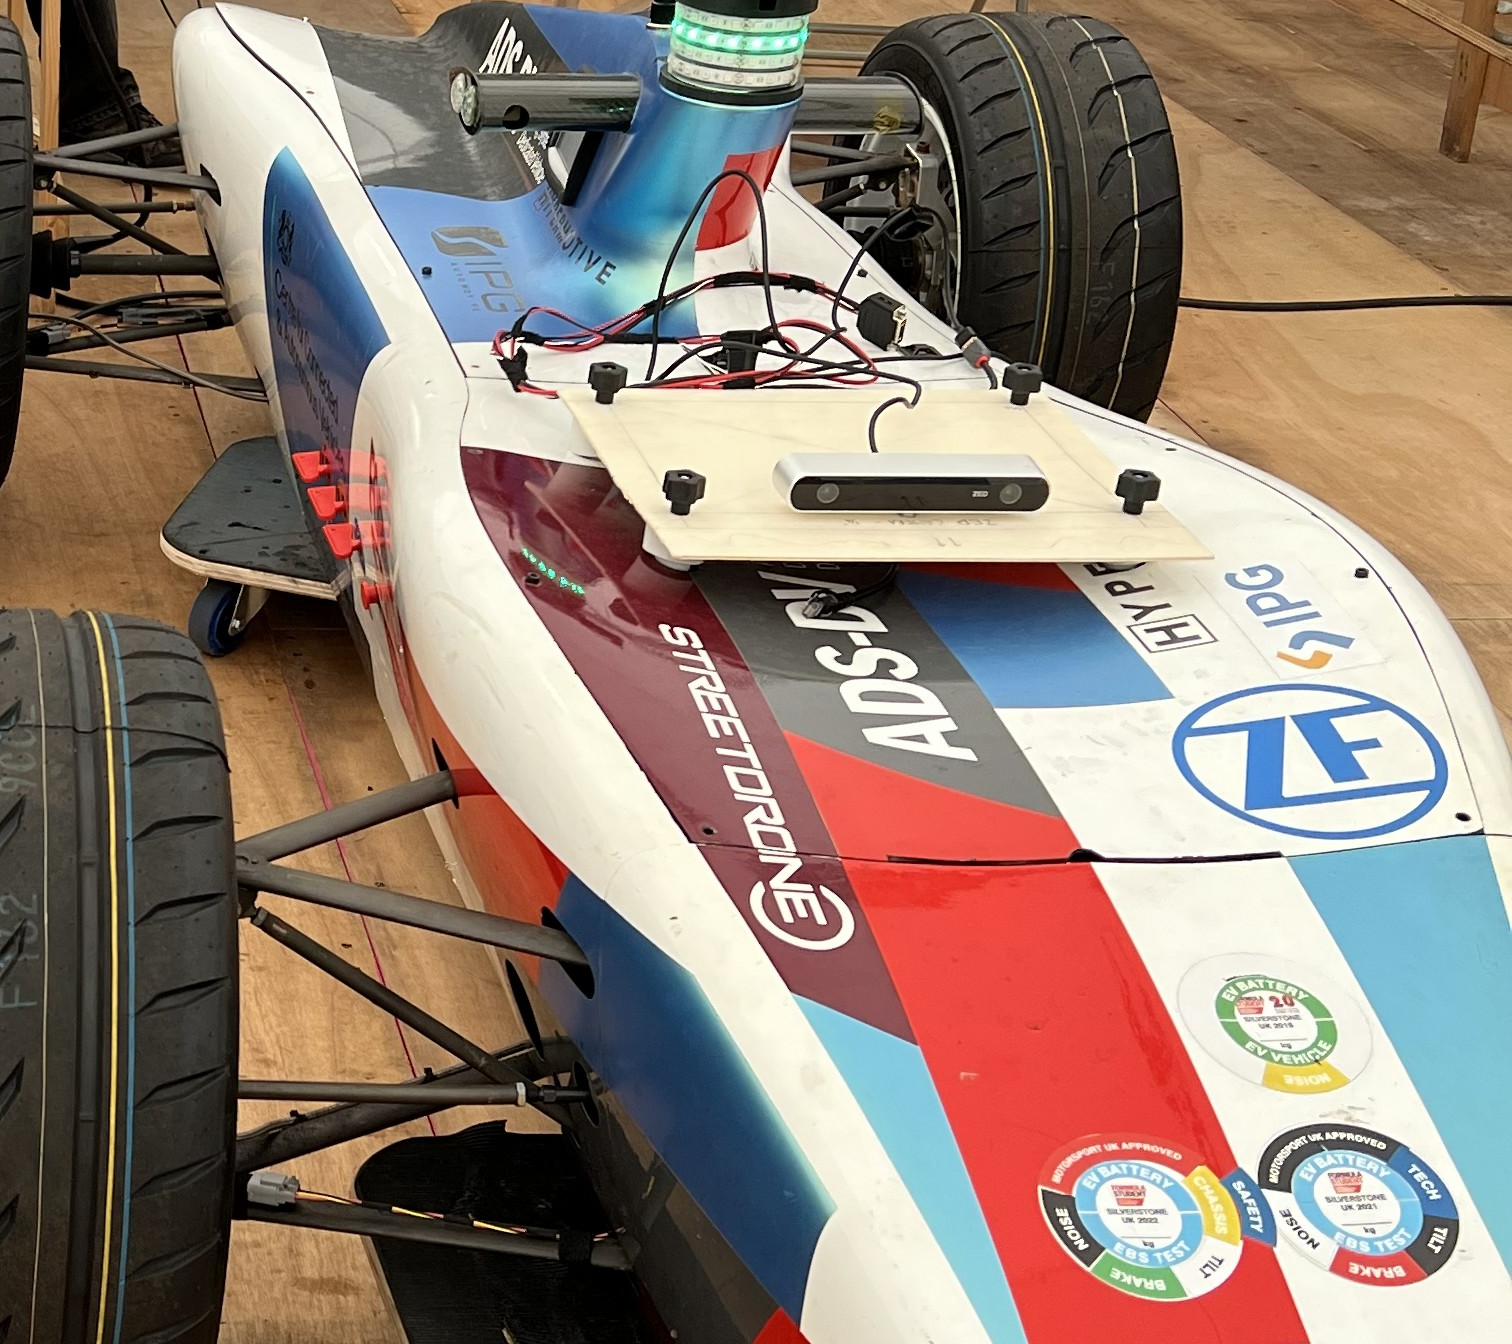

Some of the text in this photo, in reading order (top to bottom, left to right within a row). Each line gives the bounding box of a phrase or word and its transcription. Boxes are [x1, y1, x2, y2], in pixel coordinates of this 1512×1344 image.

[464, 261, 525, 313] IPG
[1224, 563, 1323, 629] IPG
[1178, 696, 1440, 821] ZF
[658, 623, 830, 930] STREETDRONE
[1221, 978, 1309, 1002] EV BATTERY
[1268, 993, 1296, 1008] 20
[1258, 1022, 1272, 1030] UK
[1245, 1039, 1333, 1065] EV VEHICLE
[1282, 1072, 1332, 1086] NOISE
[1051, 1142, 1184, 1184] MOTORSPORT UK APPROVED
[1268, 1131, 1387, 1184] MOTORSPORT UK APPROVED
[1298, 1153, 1392, 1183] EV BATTERY
[1081, 1163, 1175, 1191] EV BATTERY
[1407, 1163, 1442, 1202] TECH
[1106, 1207, 1169, 1217] SILVERSTONE
[1192, 1175, 1228, 1237] CHASSIS
[1231, 1179, 1264, 1234] SAFETY
[1325, 1193, 1387, 1203] SILVERSTONE
[1340, 1204, 1356, 1212] UK
[1055, 1206, 1090, 1252] NOISE
[1121, 1216, 1135, 1224] UK
[1278, 1207, 1321, 1251] NOISE
[1113, 1239, 1191, 1264] EBS TEST
[1333, 1227, 1413, 1255] EBS TEST
[1426, 1226, 1449, 1255] TILT
[1109, 1266, 1167, 1292] BRAKE
[1198, 1255, 1226, 1280] TILT
[1348, 1261, 1407, 1280] BRAKE
